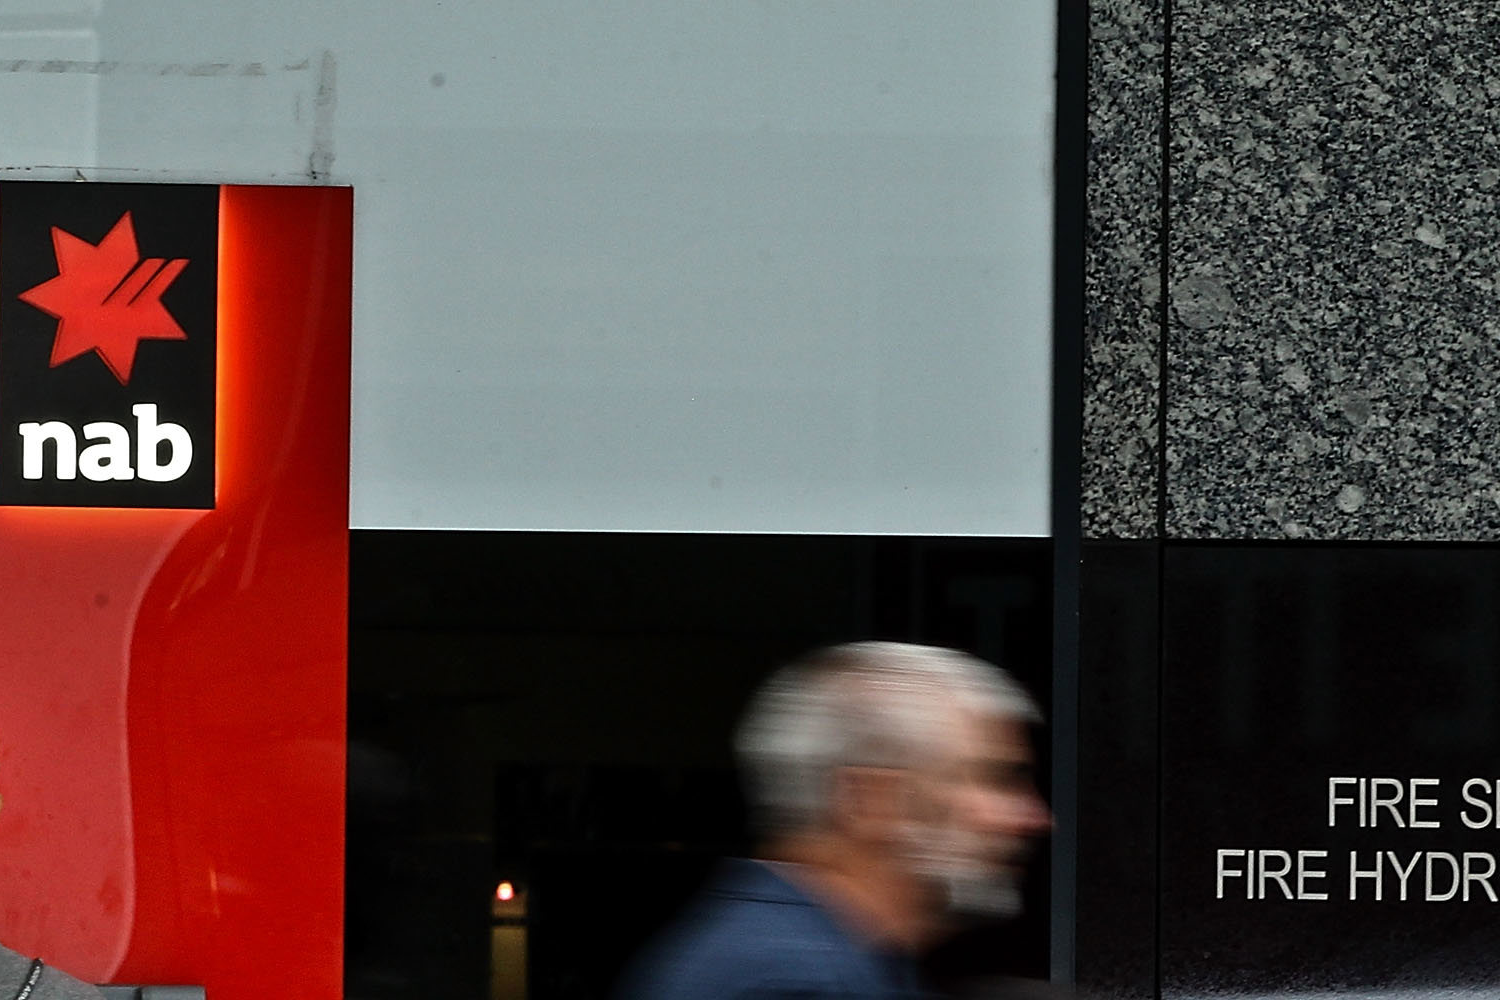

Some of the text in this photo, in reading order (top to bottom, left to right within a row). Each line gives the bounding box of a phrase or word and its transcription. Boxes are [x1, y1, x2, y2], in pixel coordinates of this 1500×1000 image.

[18, 403, 193, 482] nab
[1328, 777, 1441, 829] FIRE
[1216, 849, 1499, 903] FIRE HYDR
